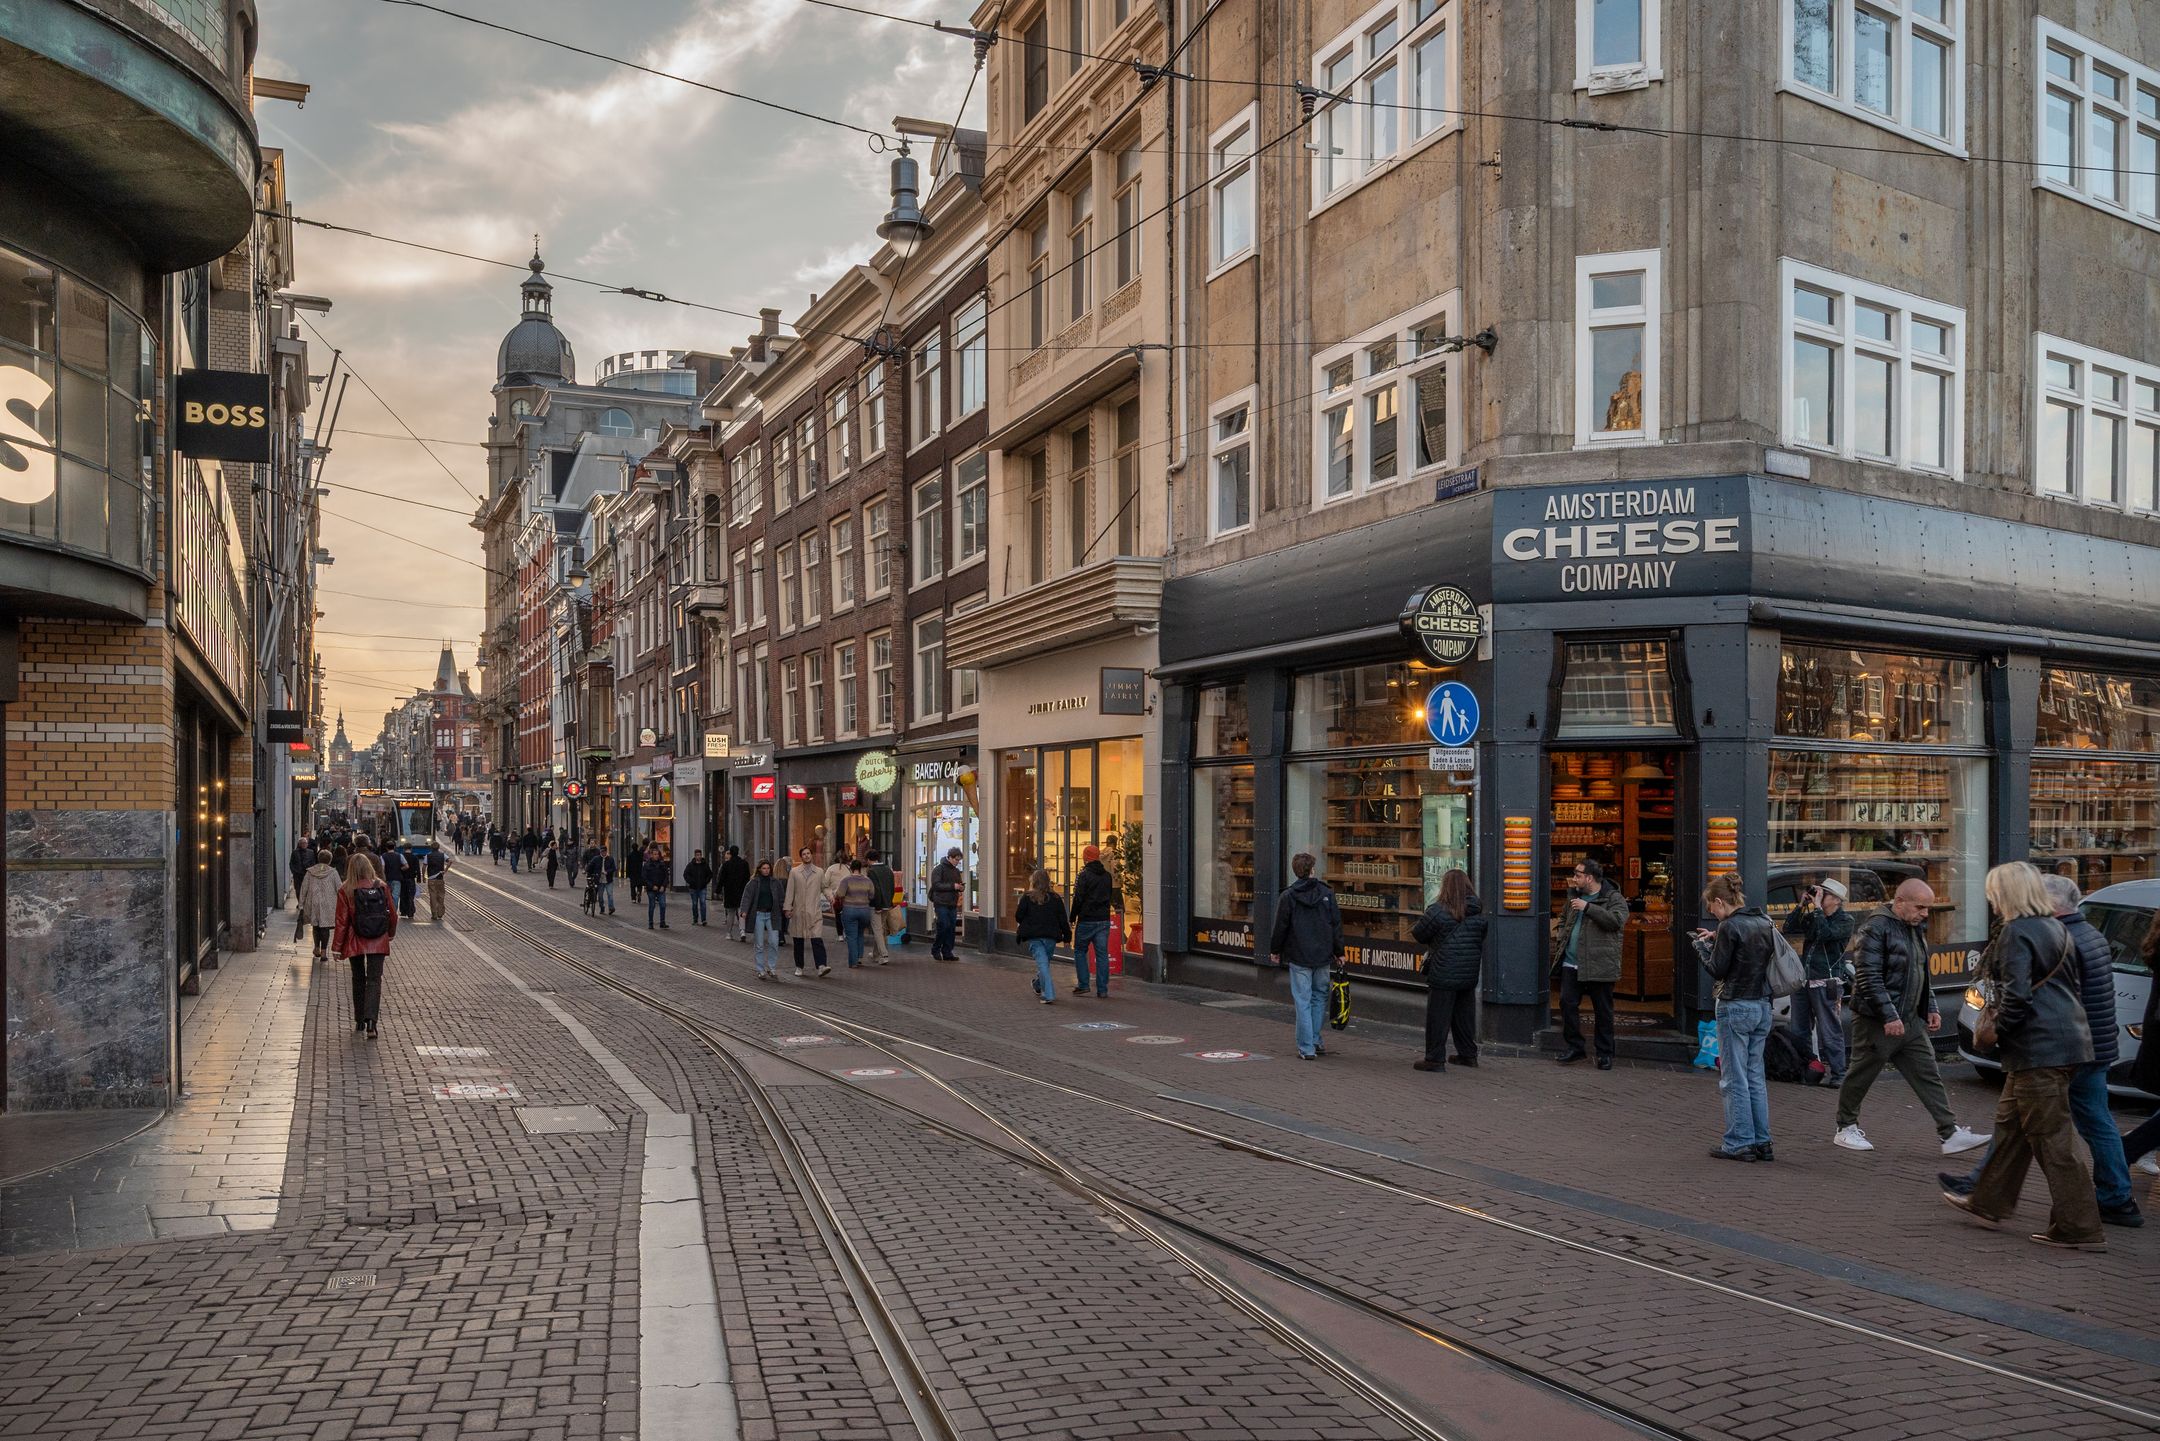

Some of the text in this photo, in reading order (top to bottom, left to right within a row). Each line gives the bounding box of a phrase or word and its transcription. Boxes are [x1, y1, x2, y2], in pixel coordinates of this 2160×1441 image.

[604, 350, 686, 377] METZ
[185, 401, 266, 428] BOSS
[1437, 470, 1476, 490] LEIDSESTRAAT
[1544, 487, 1696, 521] AMSTERDAM
[1502, 516, 1740, 561] CHEESE
[1561, 560, 1677, 593] COMPANY
[1428, 590, 1471, 612] AMSTERDAM
[1417, 616, 1479, 633] CHEESE
[1432, 639, 1467, 657] COMPANY
[1056, 696, 1088, 711] FAIRLY
[1105, 692, 1140, 700] FAIRLY
[859, 767, 894, 781] Bakery
[914, 762, 944, 780] BAKERY
[1147, 834, 1153, 847] 4
[1217, 929, 1247, 948] GOUDA
[1343, 945, 1361, 964] STE
[1361, 947, 1371, 965] OF
[1371, 949, 1414, 971] AMSTERDAM
[1929, 950, 1966, 976] ONLY
